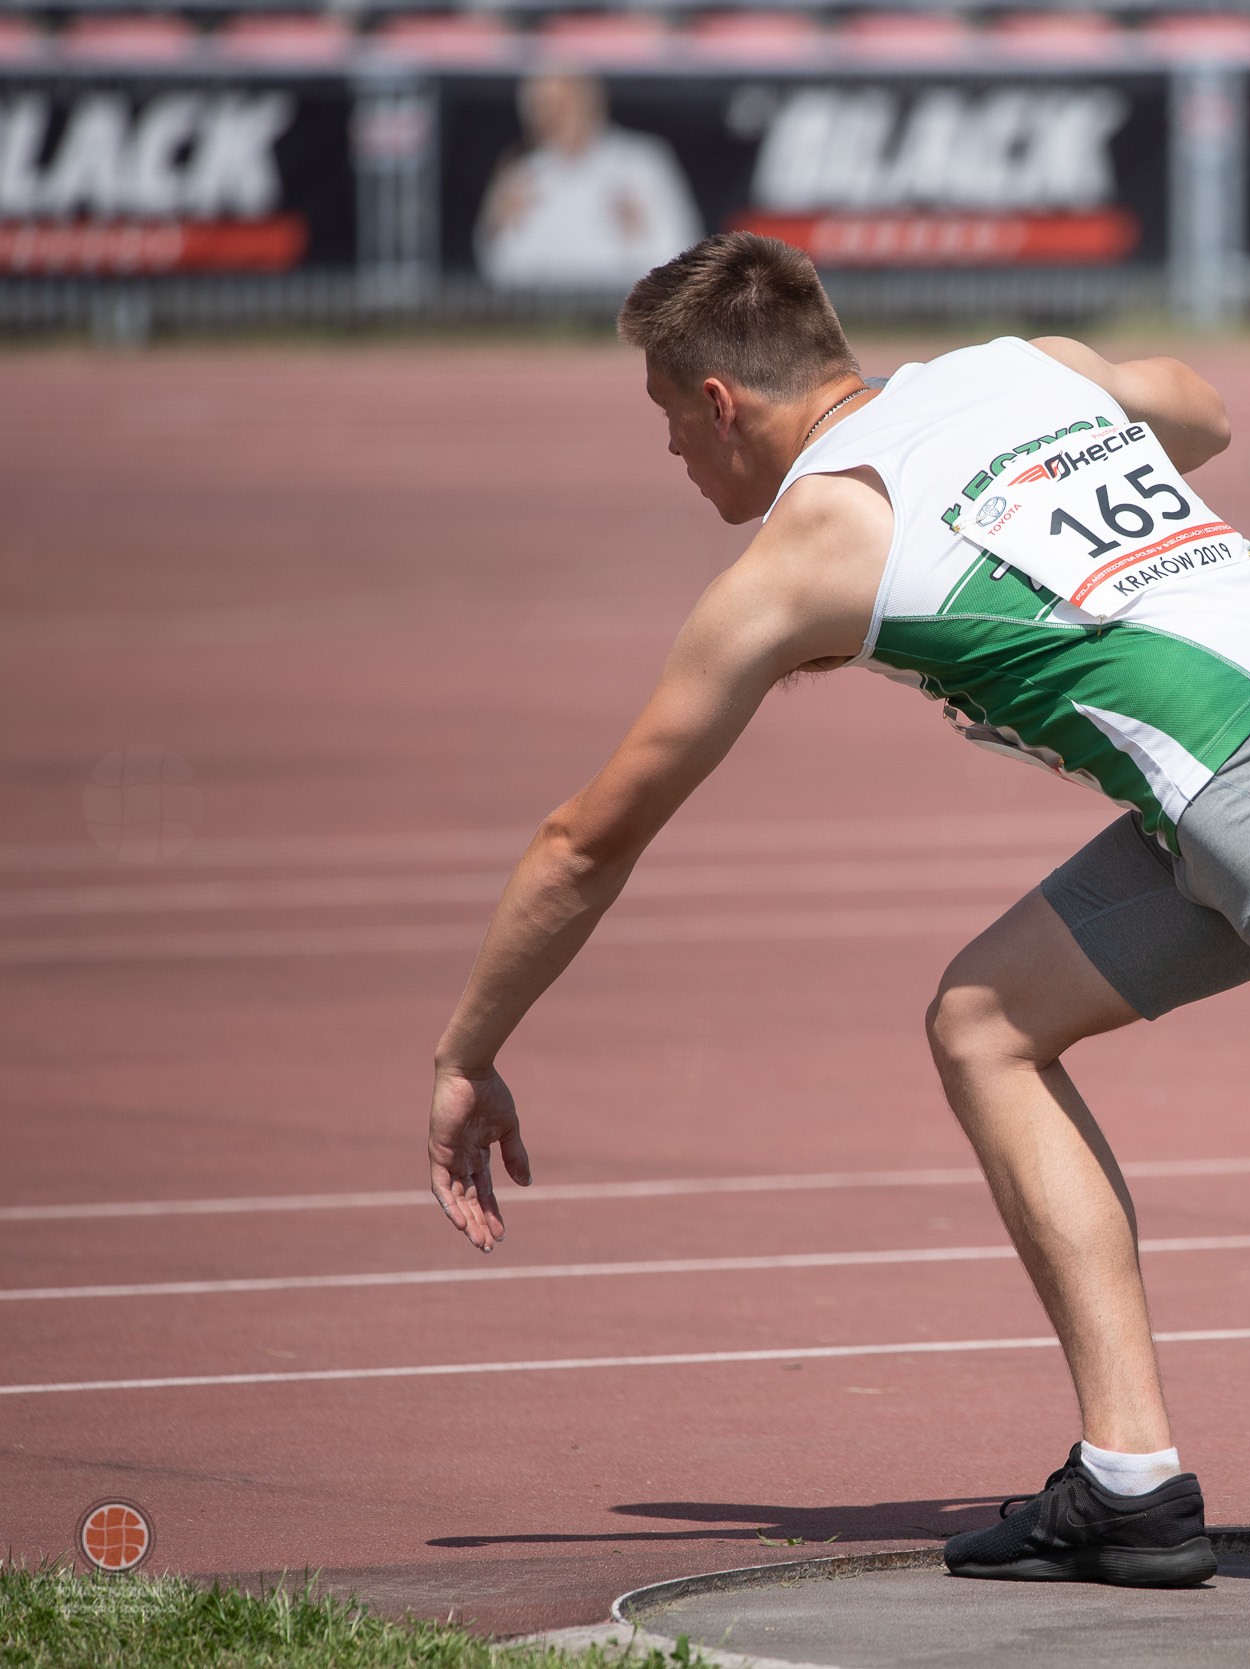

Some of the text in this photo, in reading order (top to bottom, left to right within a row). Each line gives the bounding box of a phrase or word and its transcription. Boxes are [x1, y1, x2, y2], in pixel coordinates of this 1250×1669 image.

[987, 503, 1022, 537] TOYOTA
[1050, 463, 1191, 559] 165
[1075, 583, 1093, 601] PZLA
[1136, 547, 1157, 559] POLSKI
[1113, 542, 1232, 597] KRAKÓW 2019
